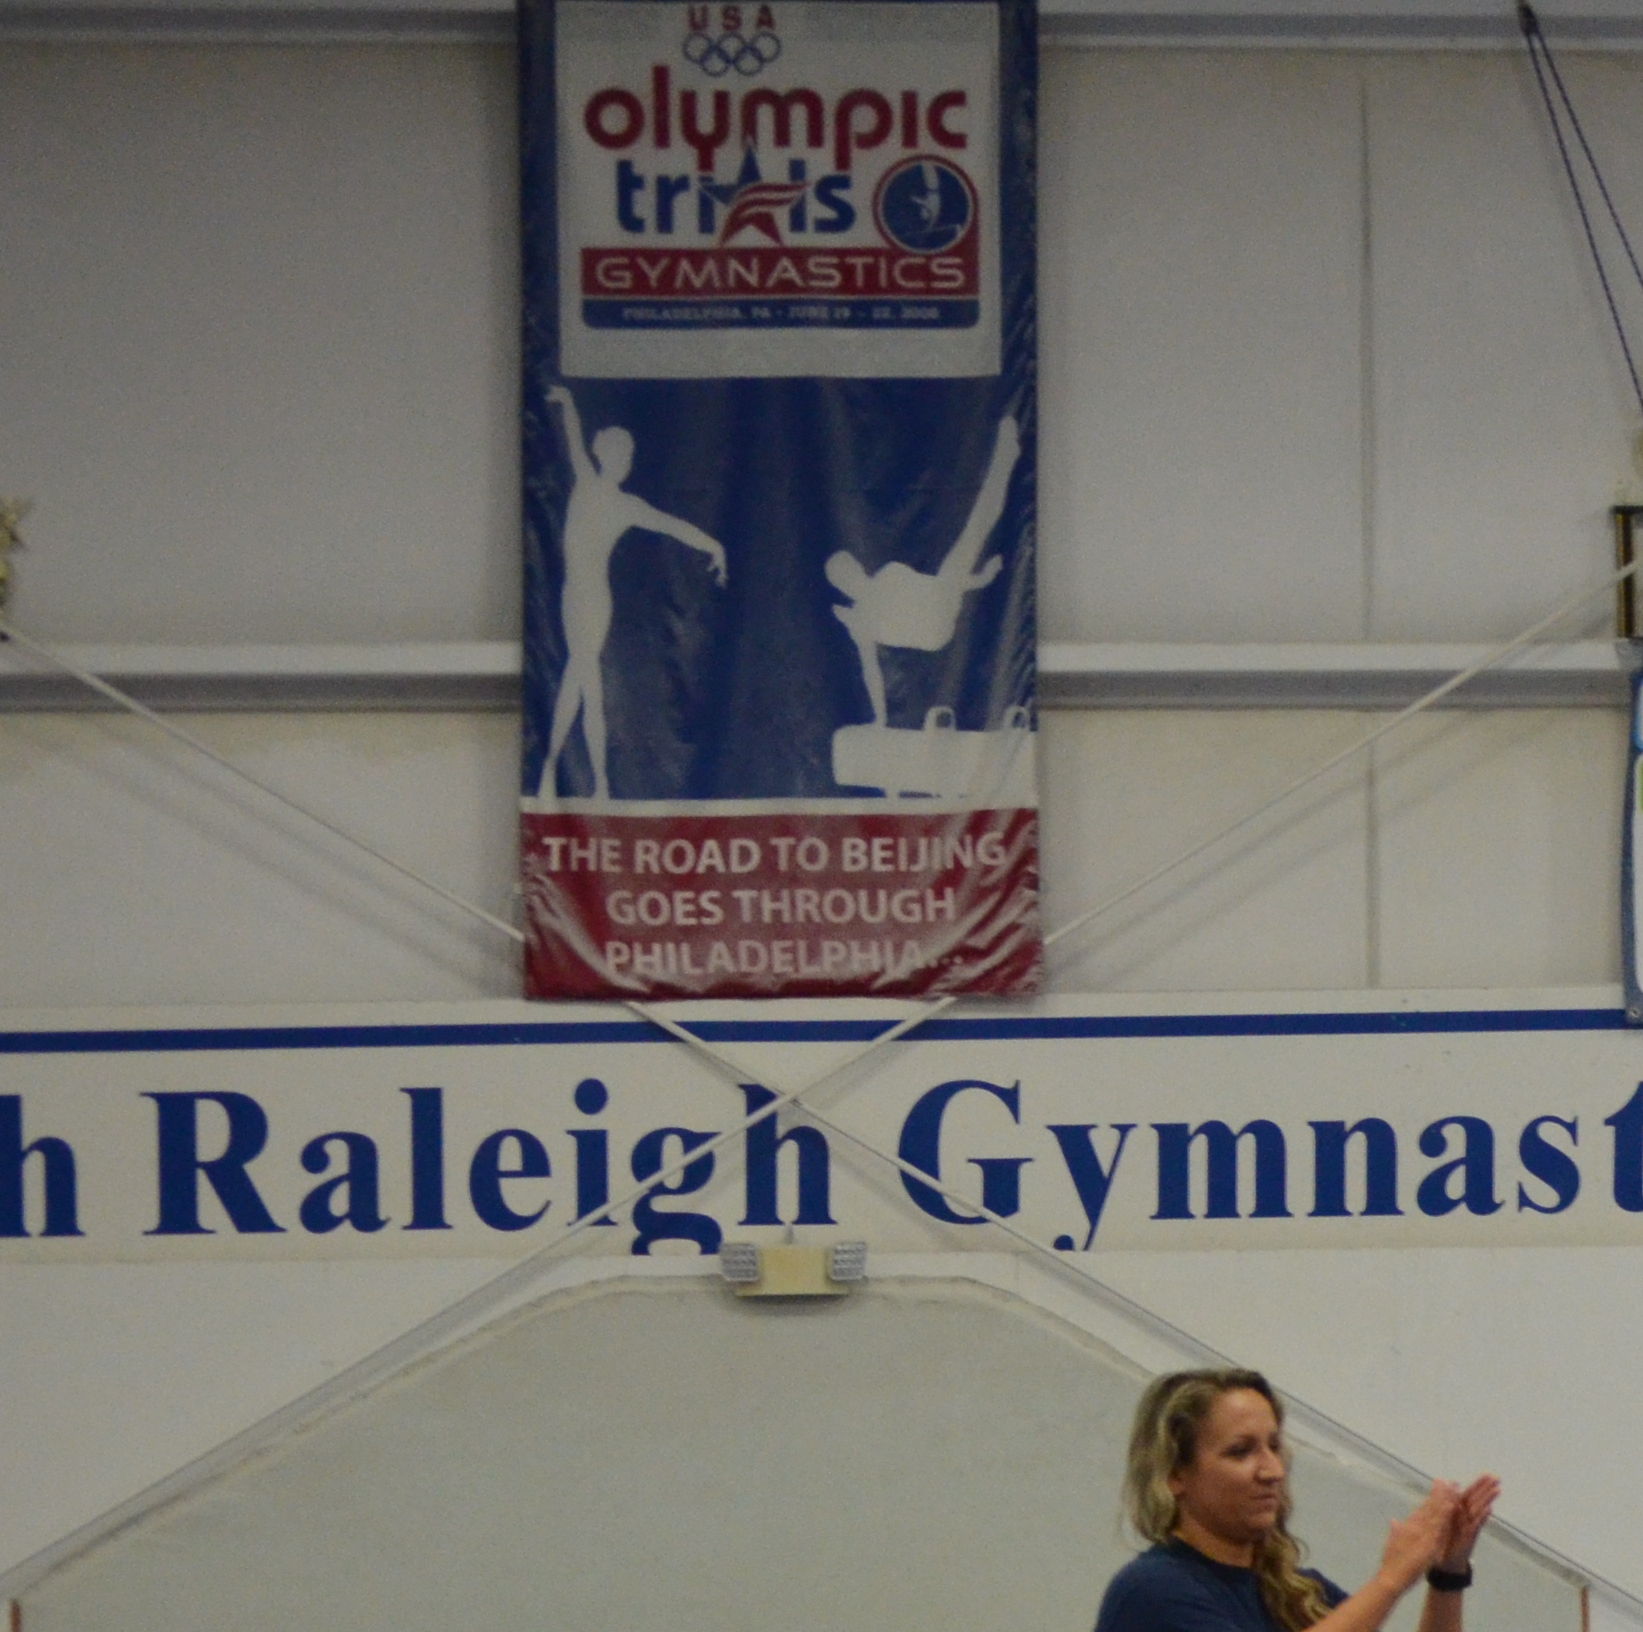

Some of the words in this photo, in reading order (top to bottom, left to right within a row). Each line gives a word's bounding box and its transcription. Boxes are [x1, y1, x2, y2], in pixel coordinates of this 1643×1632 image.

[584, 65, 968, 171] olympic
[596, 256, 965, 290] GYMNASTICS
[542, 836, 622, 872] THE
[633, 837, 762, 875] ROAD
[770, 836, 830, 873] TO
[842, 831, 1006, 874] BEIJING
[606, 889, 724, 926] GOES
[733, 886, 957, 924] THROUGH
[138, 1077, 839, 1257] Raleigh
